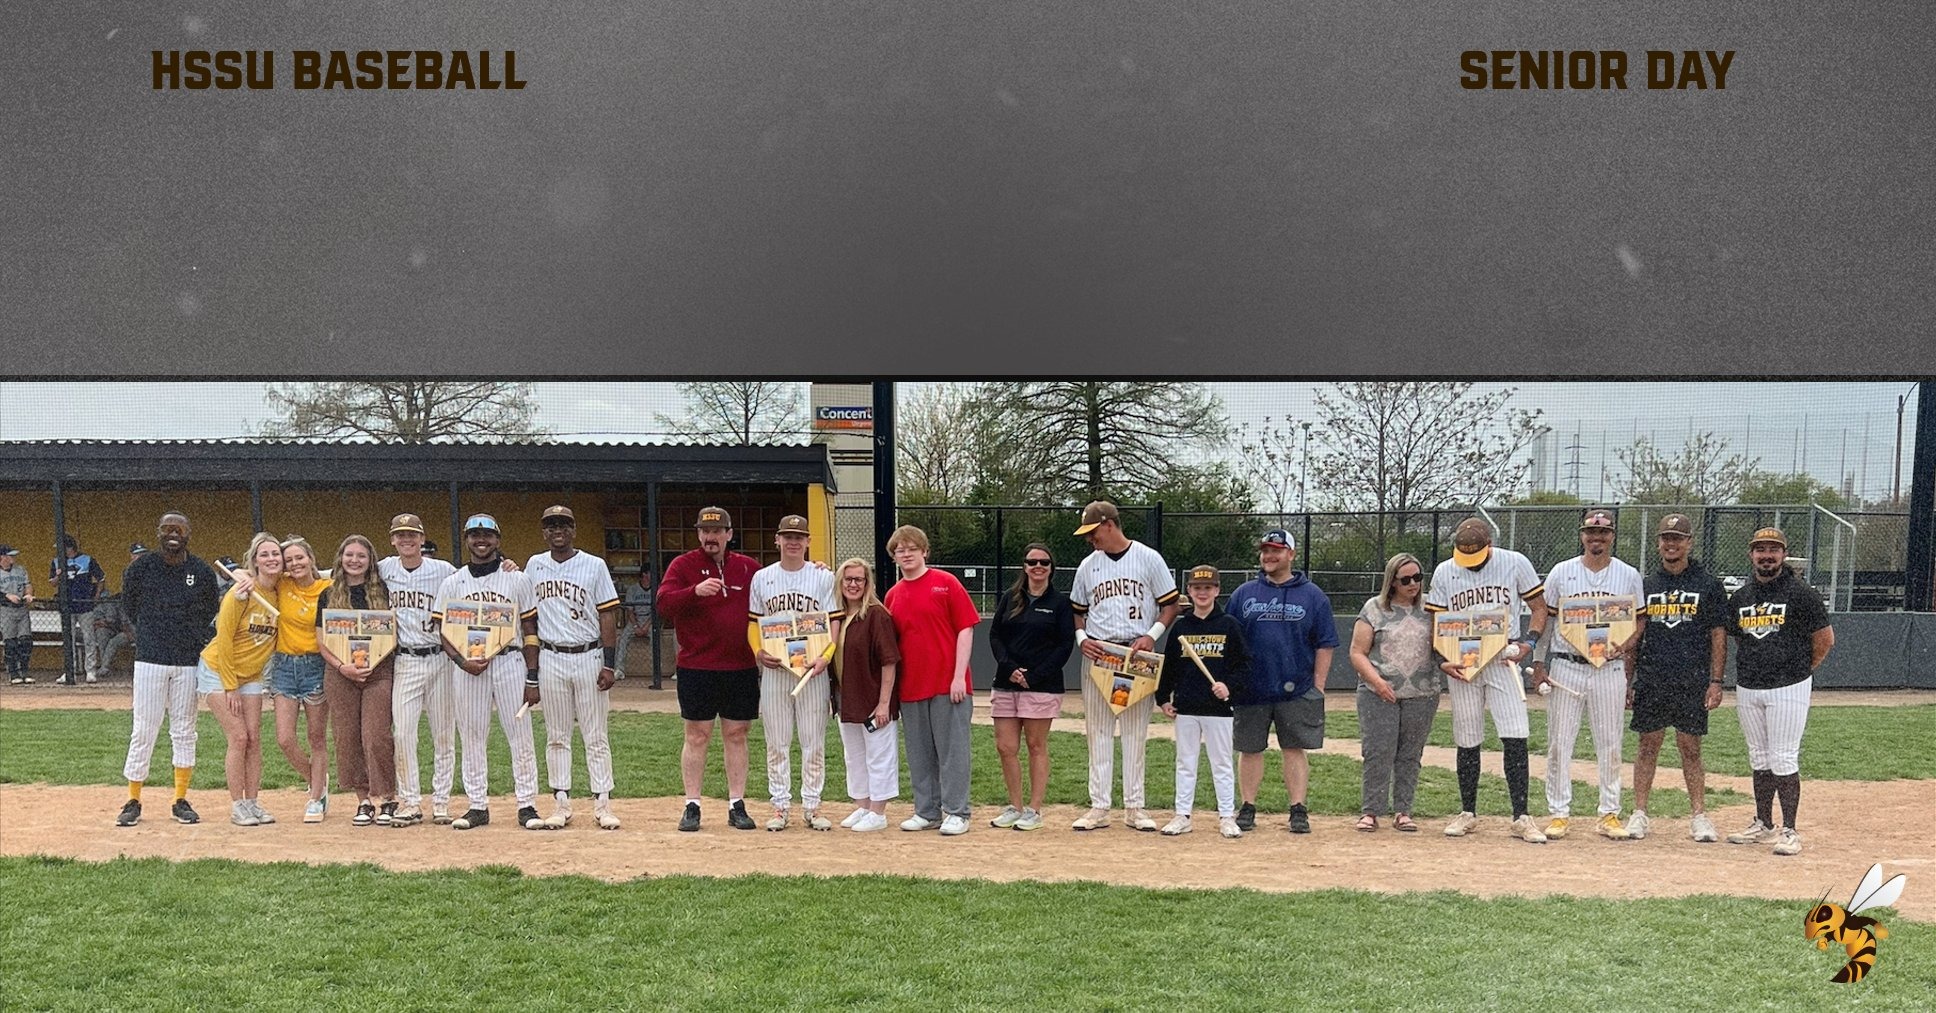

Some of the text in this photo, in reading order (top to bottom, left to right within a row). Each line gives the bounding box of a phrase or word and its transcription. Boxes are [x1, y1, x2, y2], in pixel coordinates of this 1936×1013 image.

[820, 407, 873, 420] Concent
[388, 590, 437, 612] ORNET
[1092, 578, 1144, 606] HORNETS
[1451, 586, 1511, 612] HORNETS
[1129, 606, 1143, 620] 21
